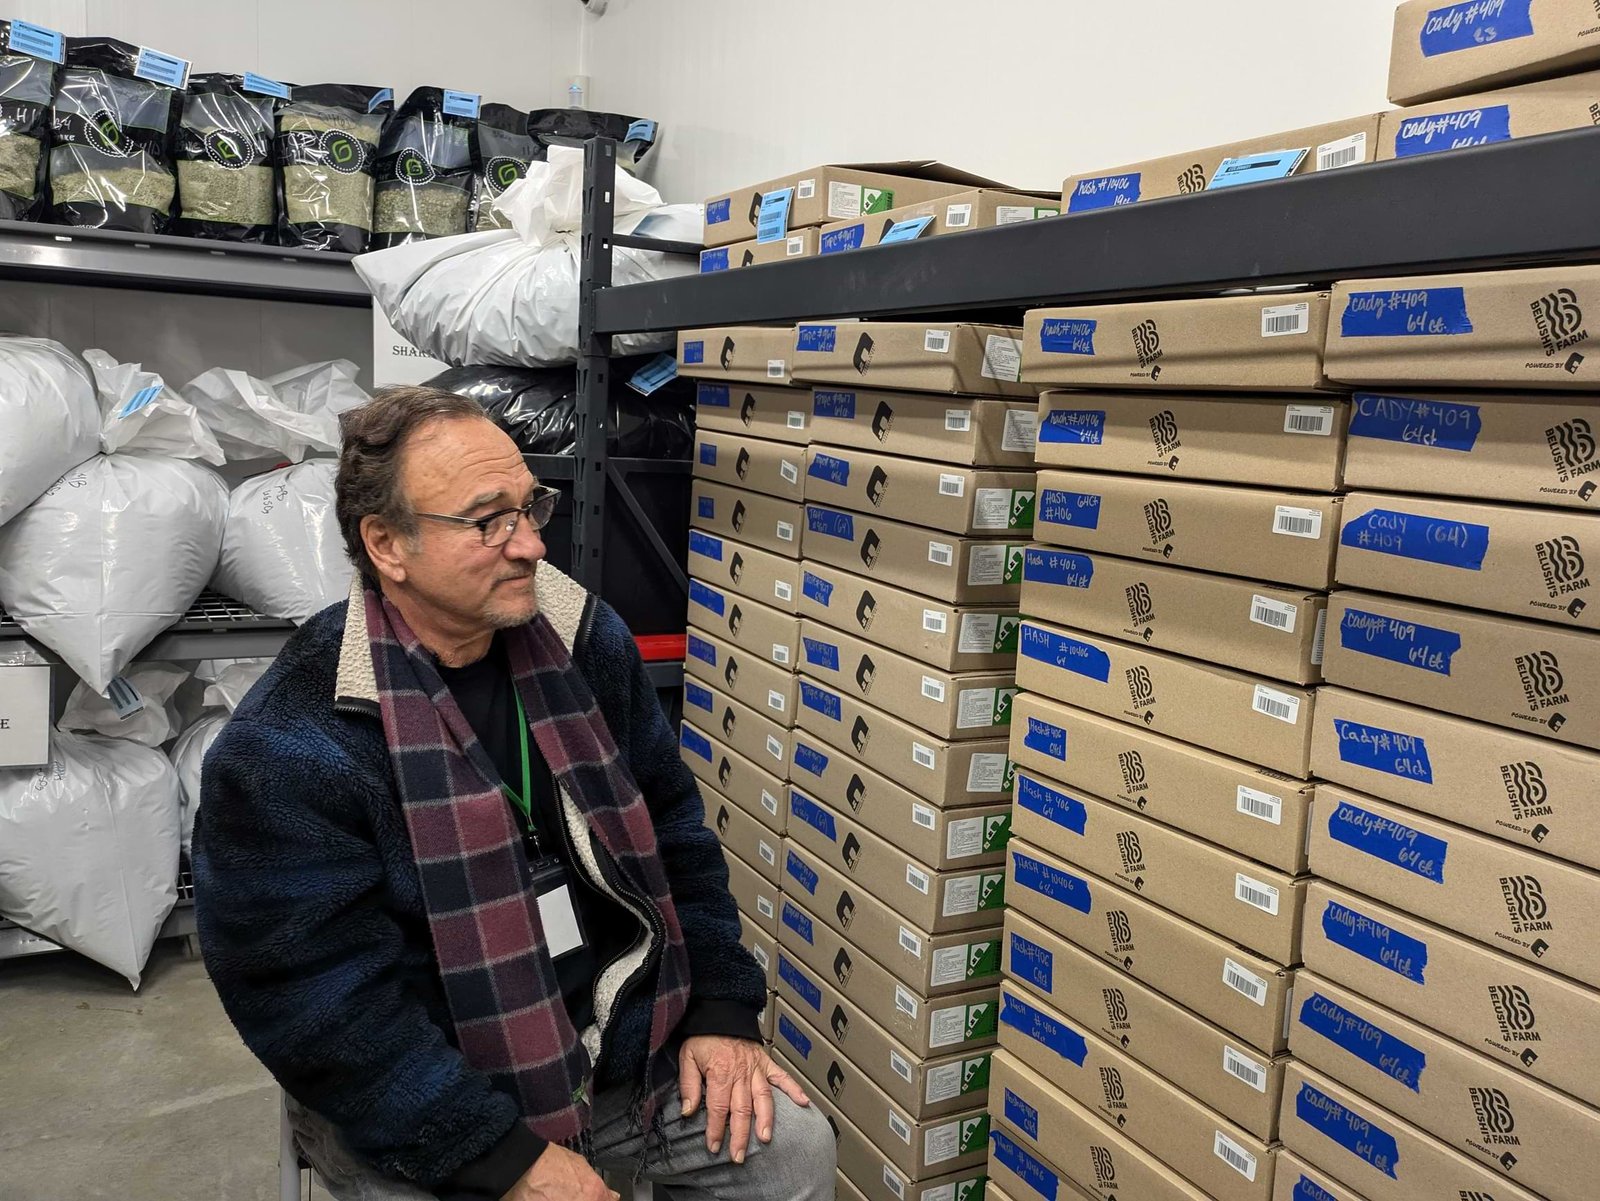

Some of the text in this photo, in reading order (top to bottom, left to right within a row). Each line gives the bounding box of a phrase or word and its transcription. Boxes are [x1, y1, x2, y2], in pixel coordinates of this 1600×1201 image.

[1530, 300, 1556, 357] BELUSHI'S
[1556, 330, 1589, 351] FARM
[1146, 349, 1163, 365] FARM
[1525, 362, 1564, 370] POWERED BY
[1164, 441, 1182, 455] FARM
[1545, 428, 1569, 483] BELUSHI'S
[1570, 460, 1600, 478] FARM
[1539, 486, 1578, 496] POWERED BY
[1158, 529, 1176, 543] FARM
[1535, 543, 1559, 599] BELUSHI'S
[1560, 578, 1591, 595] FARM
[1529, 600, 1558, 610] POWERED
[1138, 613, 1156, 626] FARM
[1514, 656, 1539, 711] BELUSHI'S
[1139, 697, 1157, 709] FARM
[1539, 694, 1570, 709] FARM
[1511, 711, 1548, 726] POWERED BY
[1117, 753, 1132, 794] BELUSHI'S
[1132, 782, 1149, 793] FARM
[1500, 765, 1523, 821] BELUSHI'S
[1524, 805, 1553, 819] FARM
[1495, 820, 1523, 833] POWERED
[1116, 833, 1130, 874] BELUSHI'S
[1130, 864, 1146, 873] FARM
[1499, 877, 1523, 934] BELUSHI'S
[1106, 911, 1119, 953] BELUSHI'S
[1524, 921, 1553, 932] FARM
[1494, 932, 1523, 946] POWERED
[1119, 943, 1135, 952] FARM
[1488, 985, 1512, 1042] BELUSHI'S
[1116, 1022, 1131, 1030] FARM
[1512, 1031, 1541, 1042] FARM
[1485, 1038, 1511, 1055] POWERED
[1468, 1087, 1491, 1144] BELUSHI'S
[1465, 1138, 1493, 1156] POWERED
[1492, 1134, 1520, 1145] FARM
[1103, 1181, 1119, 1190] FARM
